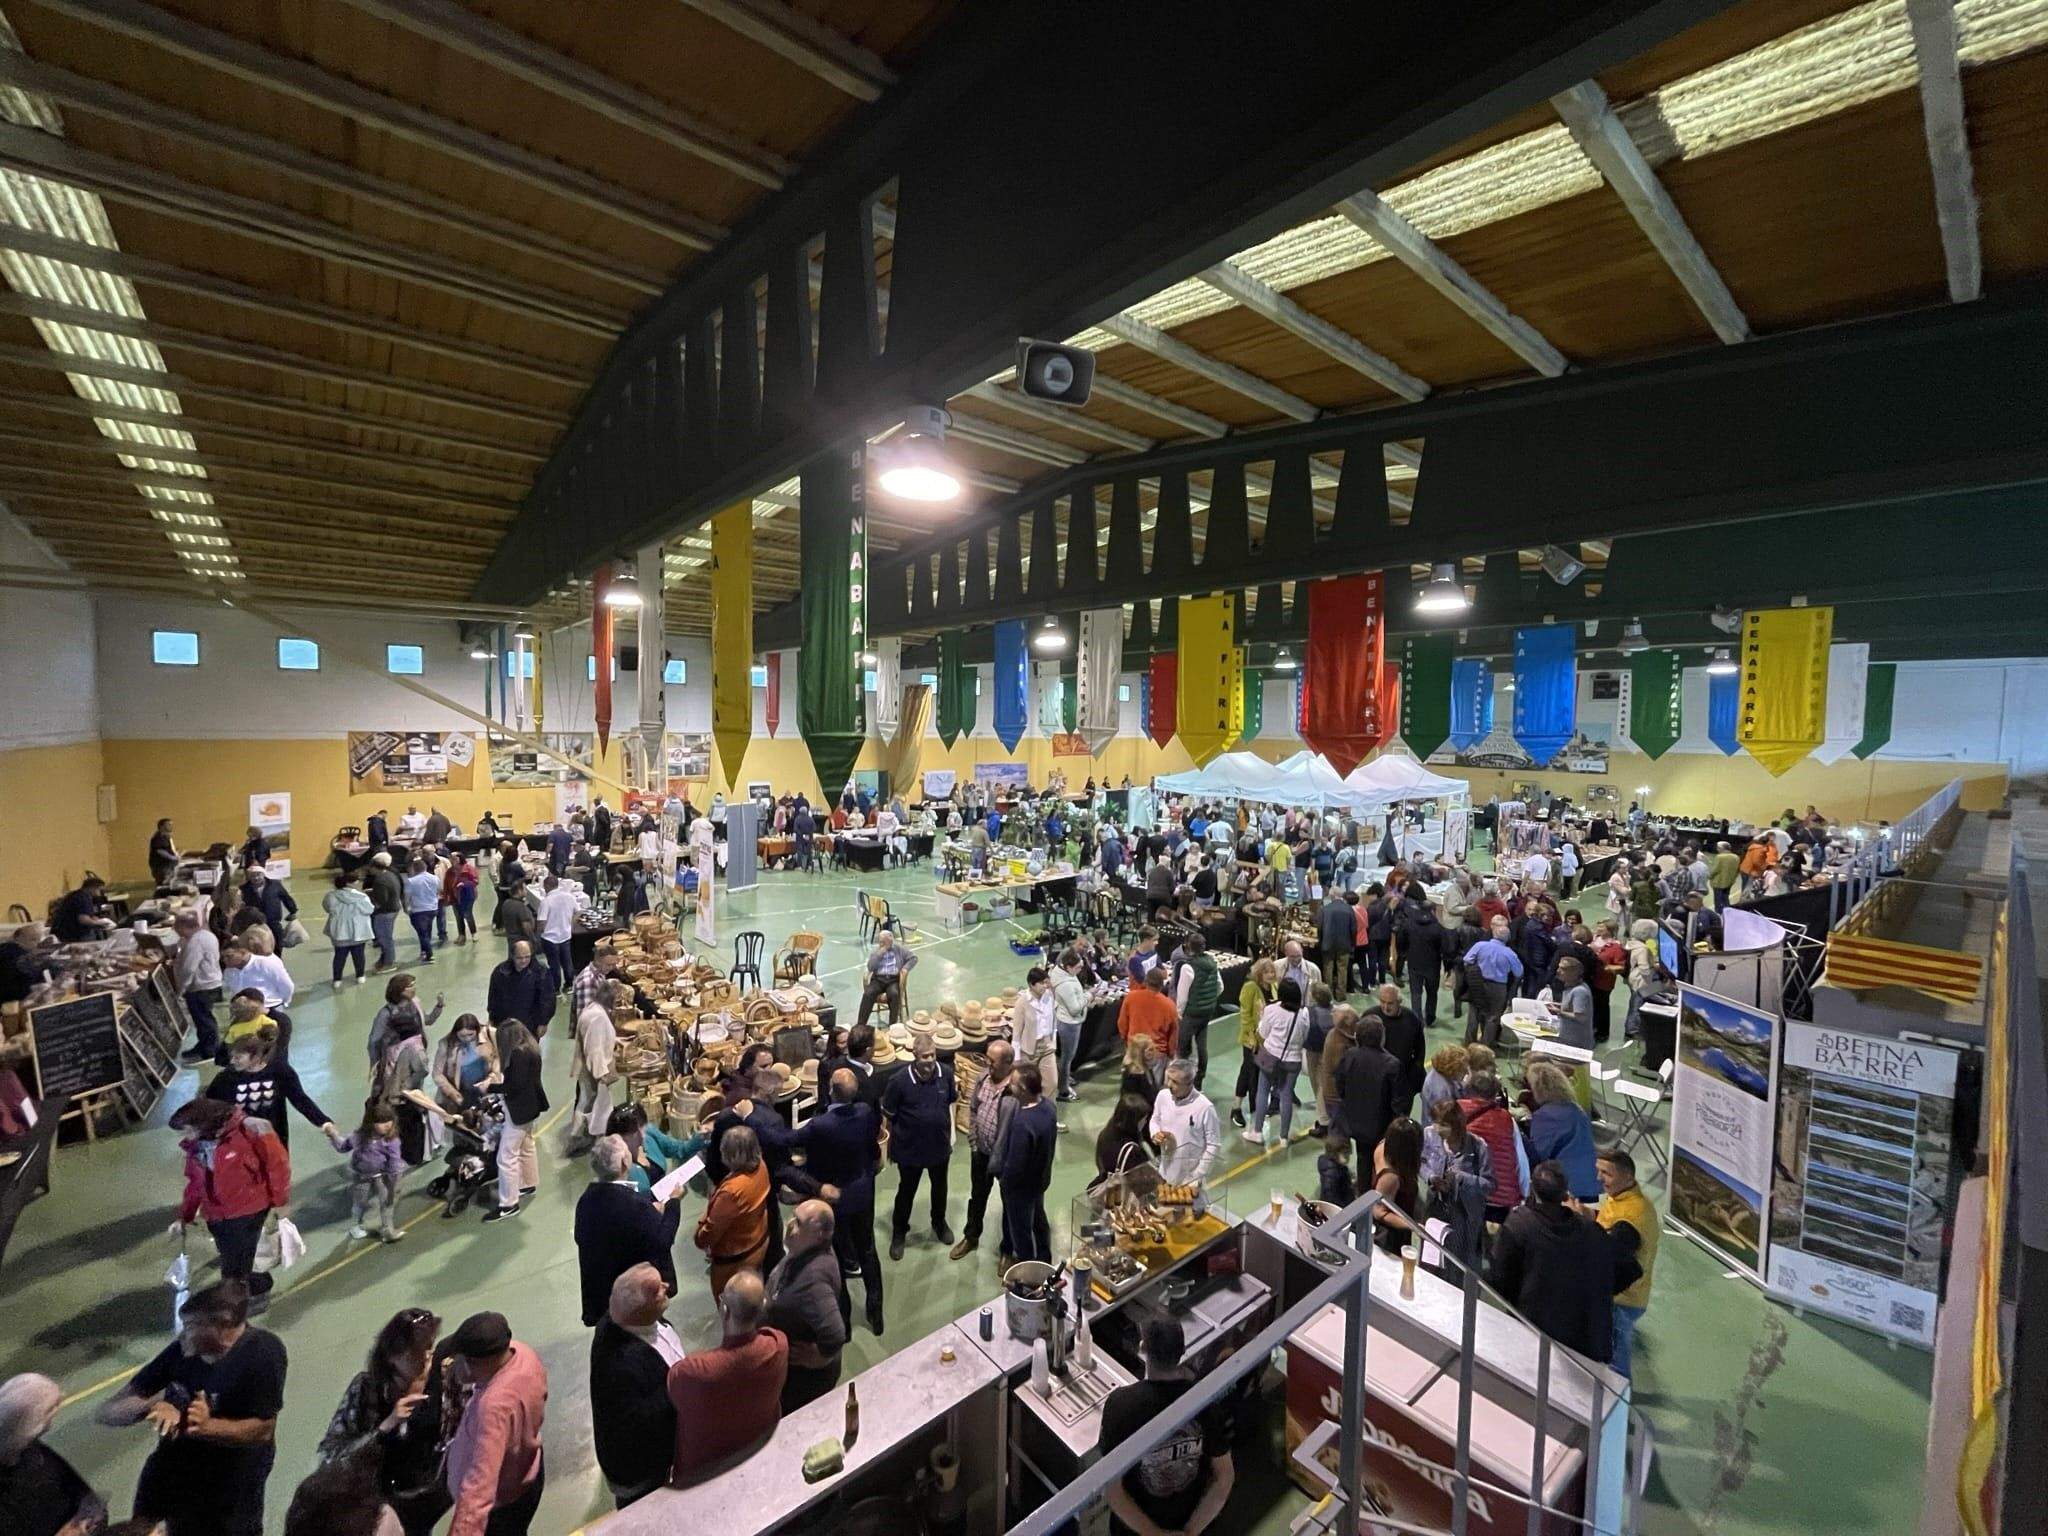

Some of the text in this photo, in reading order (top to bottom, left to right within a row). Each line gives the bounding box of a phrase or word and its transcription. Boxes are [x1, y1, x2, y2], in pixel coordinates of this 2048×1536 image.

[1217, 598, 1230, 731] LA FIRA
[1365, 579, 1377, 734] BENABARRE
[1404, 640, 1412, 735] BENABARRE
[1516, 631, 1525, 734] LA FIRA
[1744, 615, 1760, 740] BENABARRE
